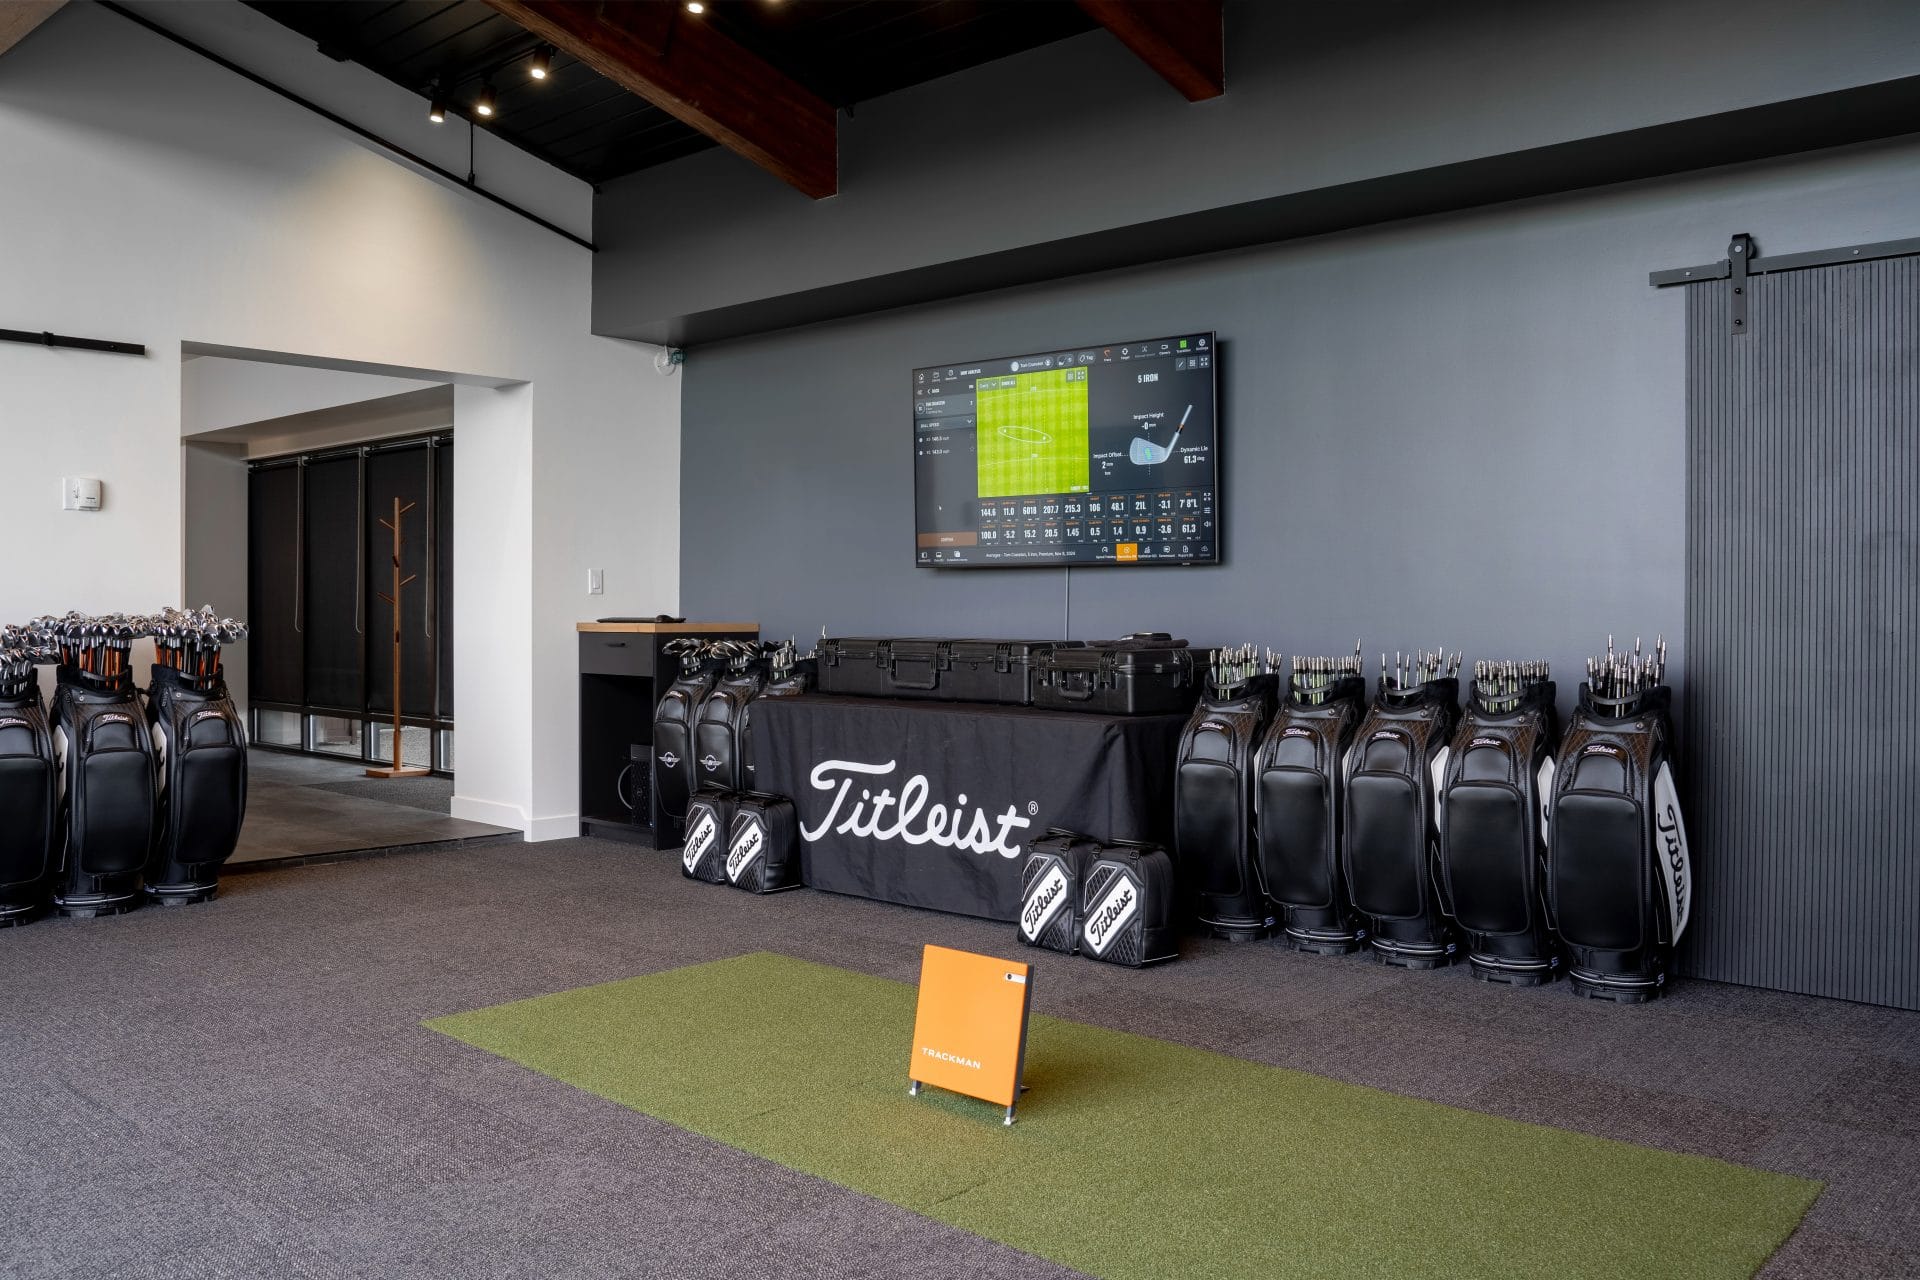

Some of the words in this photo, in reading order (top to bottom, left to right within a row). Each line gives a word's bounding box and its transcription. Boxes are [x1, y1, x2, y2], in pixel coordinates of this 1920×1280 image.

[1137, 374, 1142, 383] 5
[1143, 373, 1159, 383] IRON
[1183, 454, 1197, 464] 61.3
[1101, 461, 1106, 469] 2
[981, 508, 997, 517] 144.6
[1003, 507, 1015, 516] 11.0
[1043, 505, 1059, 514] 207.7
[1064, 503, 1081, 513] 215.3
[1089, 503, 1101, 512] 106
[1158, 500, 1171, 509] -3.1
[981, 530, 997, 539] 100.0
[1003, 530, 1015, 539] -5.2
[1024, 529, 1036, 538] 15.2
[1044, 528, 1058, 538] 20.5
[1066, 527, 1080, 537] 1.45
[1090, 527, 1101, 536] 0.5
[1113, 526, 1123, 535] 1.4
[1135, 525, 1147, 535] 0.9
[1158, 524, 1172, 534] -3.6
[1182, 523, 1196, 533] 61.3
[102, 714, 129, 723] Titleist
[197, 710, 223, 720] Titleist
[0, 718, 28, 726] Titleist
[1198, 722, 1225, 731] Titleist
[1282, 728, 1311, 737] Titleist
[1372, 731, 1401, 740] Titleist
[1469, 738, 1501, 747] Titleist
[1583, 745, 1618, 755] Titleist
[800, 759, 1031, 859] Titleist
[685, 823, 713, 868] Titleist
[729, 832, 759, 877] Titleist
[1024, 878, 1063, 935] Titleist
[1090, 889, 1133, 946] Titleist
[922, 1047, 982, 1070] TRACKMAN
